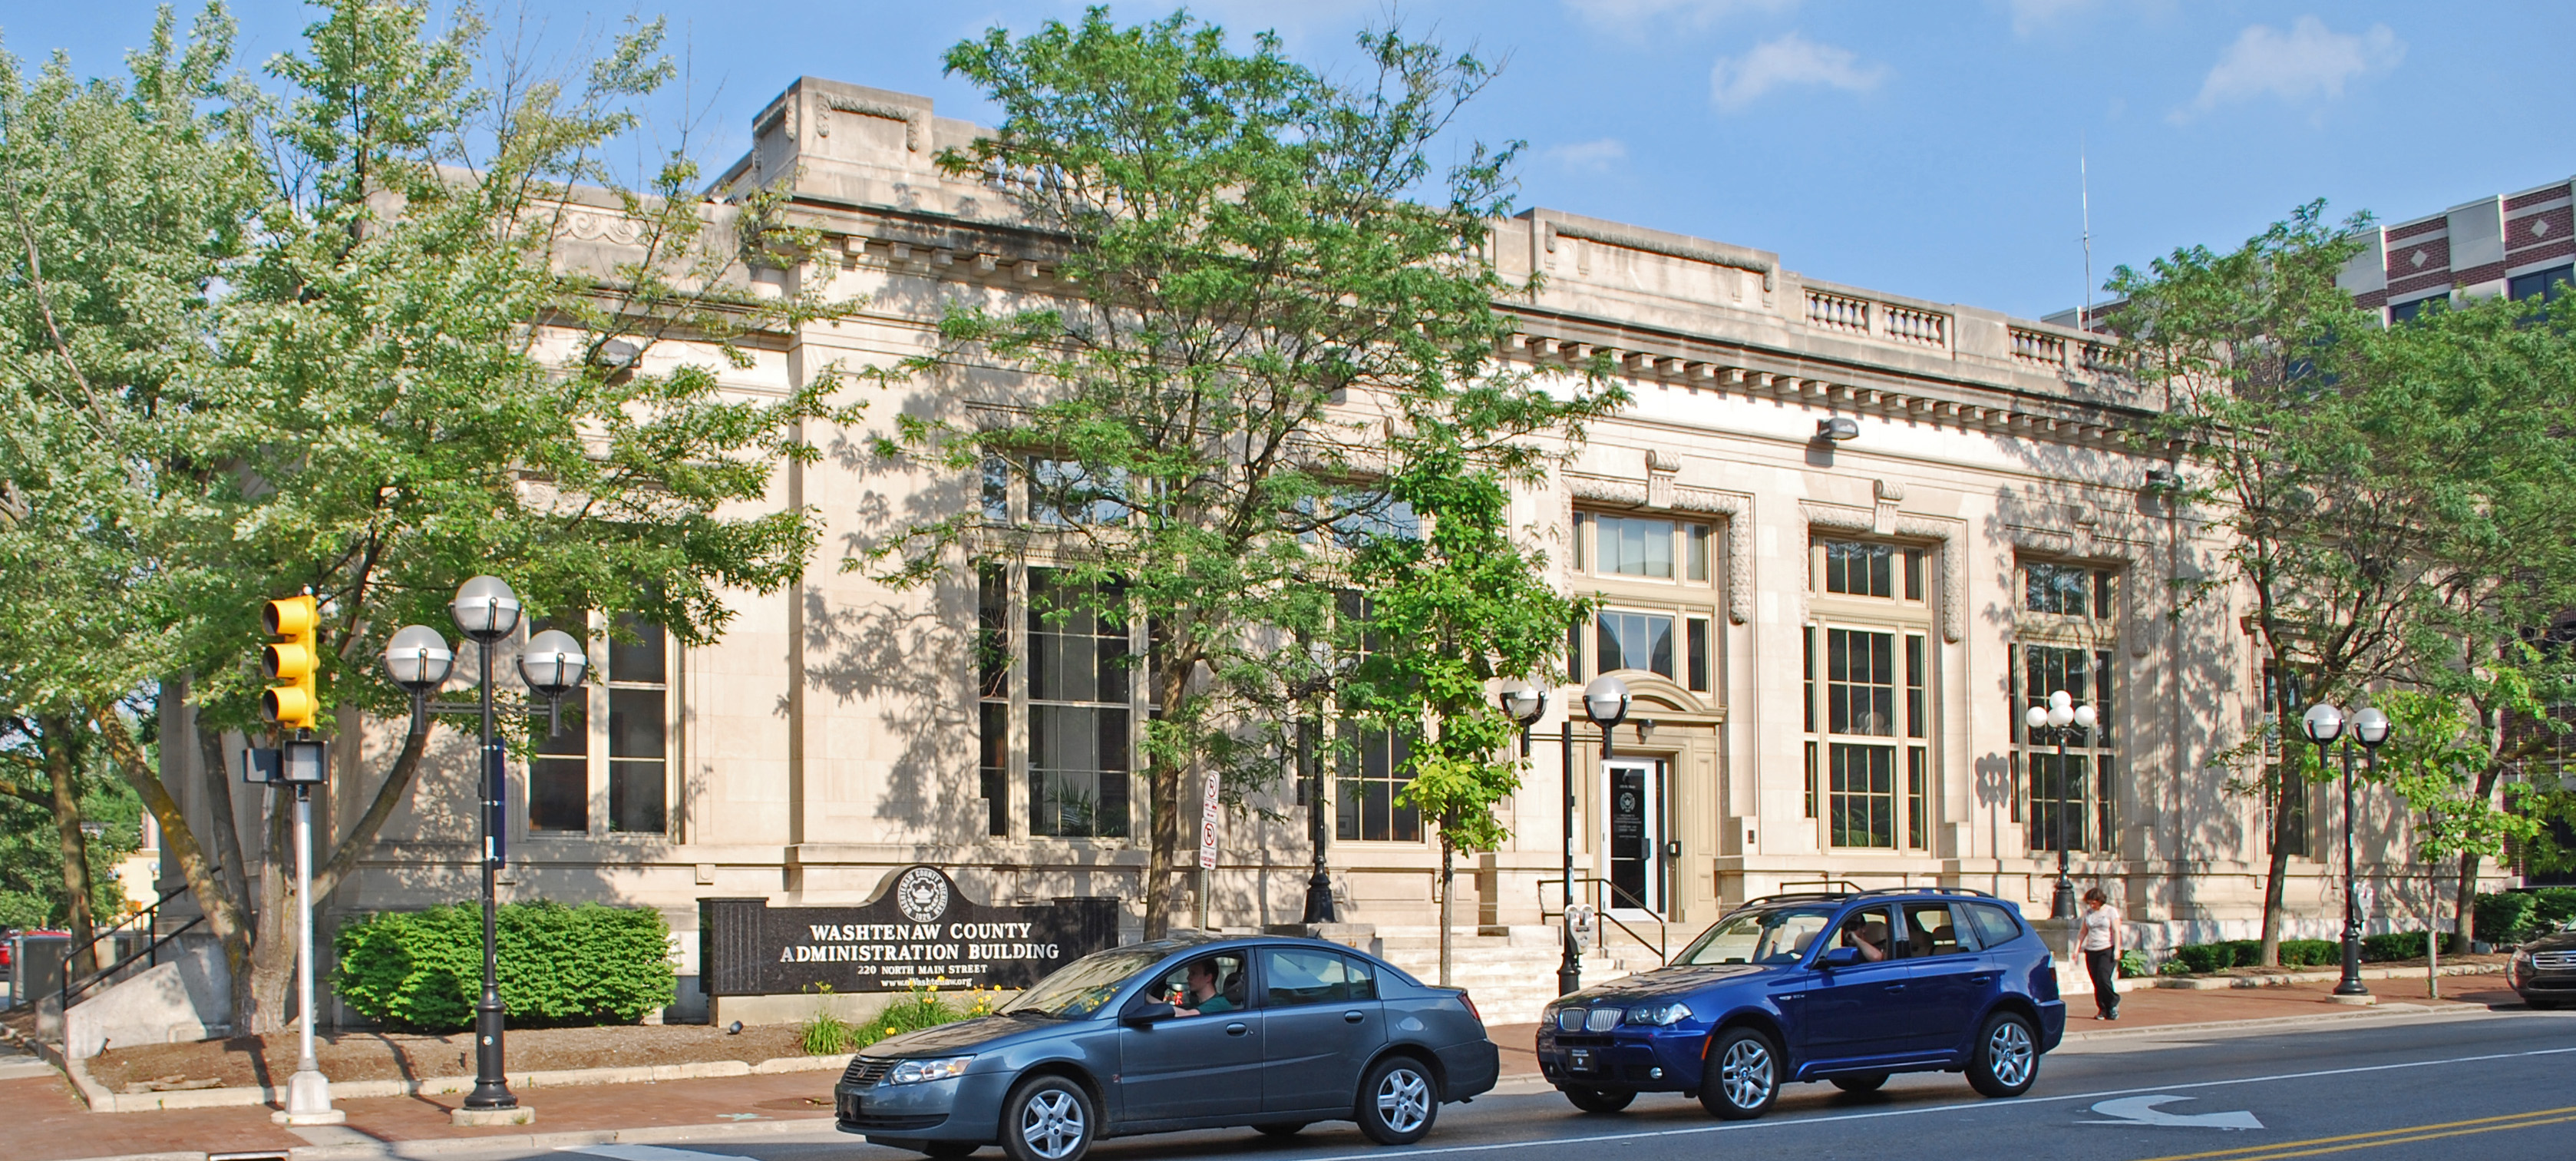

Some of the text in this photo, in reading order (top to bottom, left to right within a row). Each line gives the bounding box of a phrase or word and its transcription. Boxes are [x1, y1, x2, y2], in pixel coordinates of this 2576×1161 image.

[810, 923, 1032, 941] WASHTENAW COUNTY
[780, 944, 1059, 962] ADMINISTRATION BUILDING
[857, 964, 988, 975] 220 NORTH MAIN STREET
